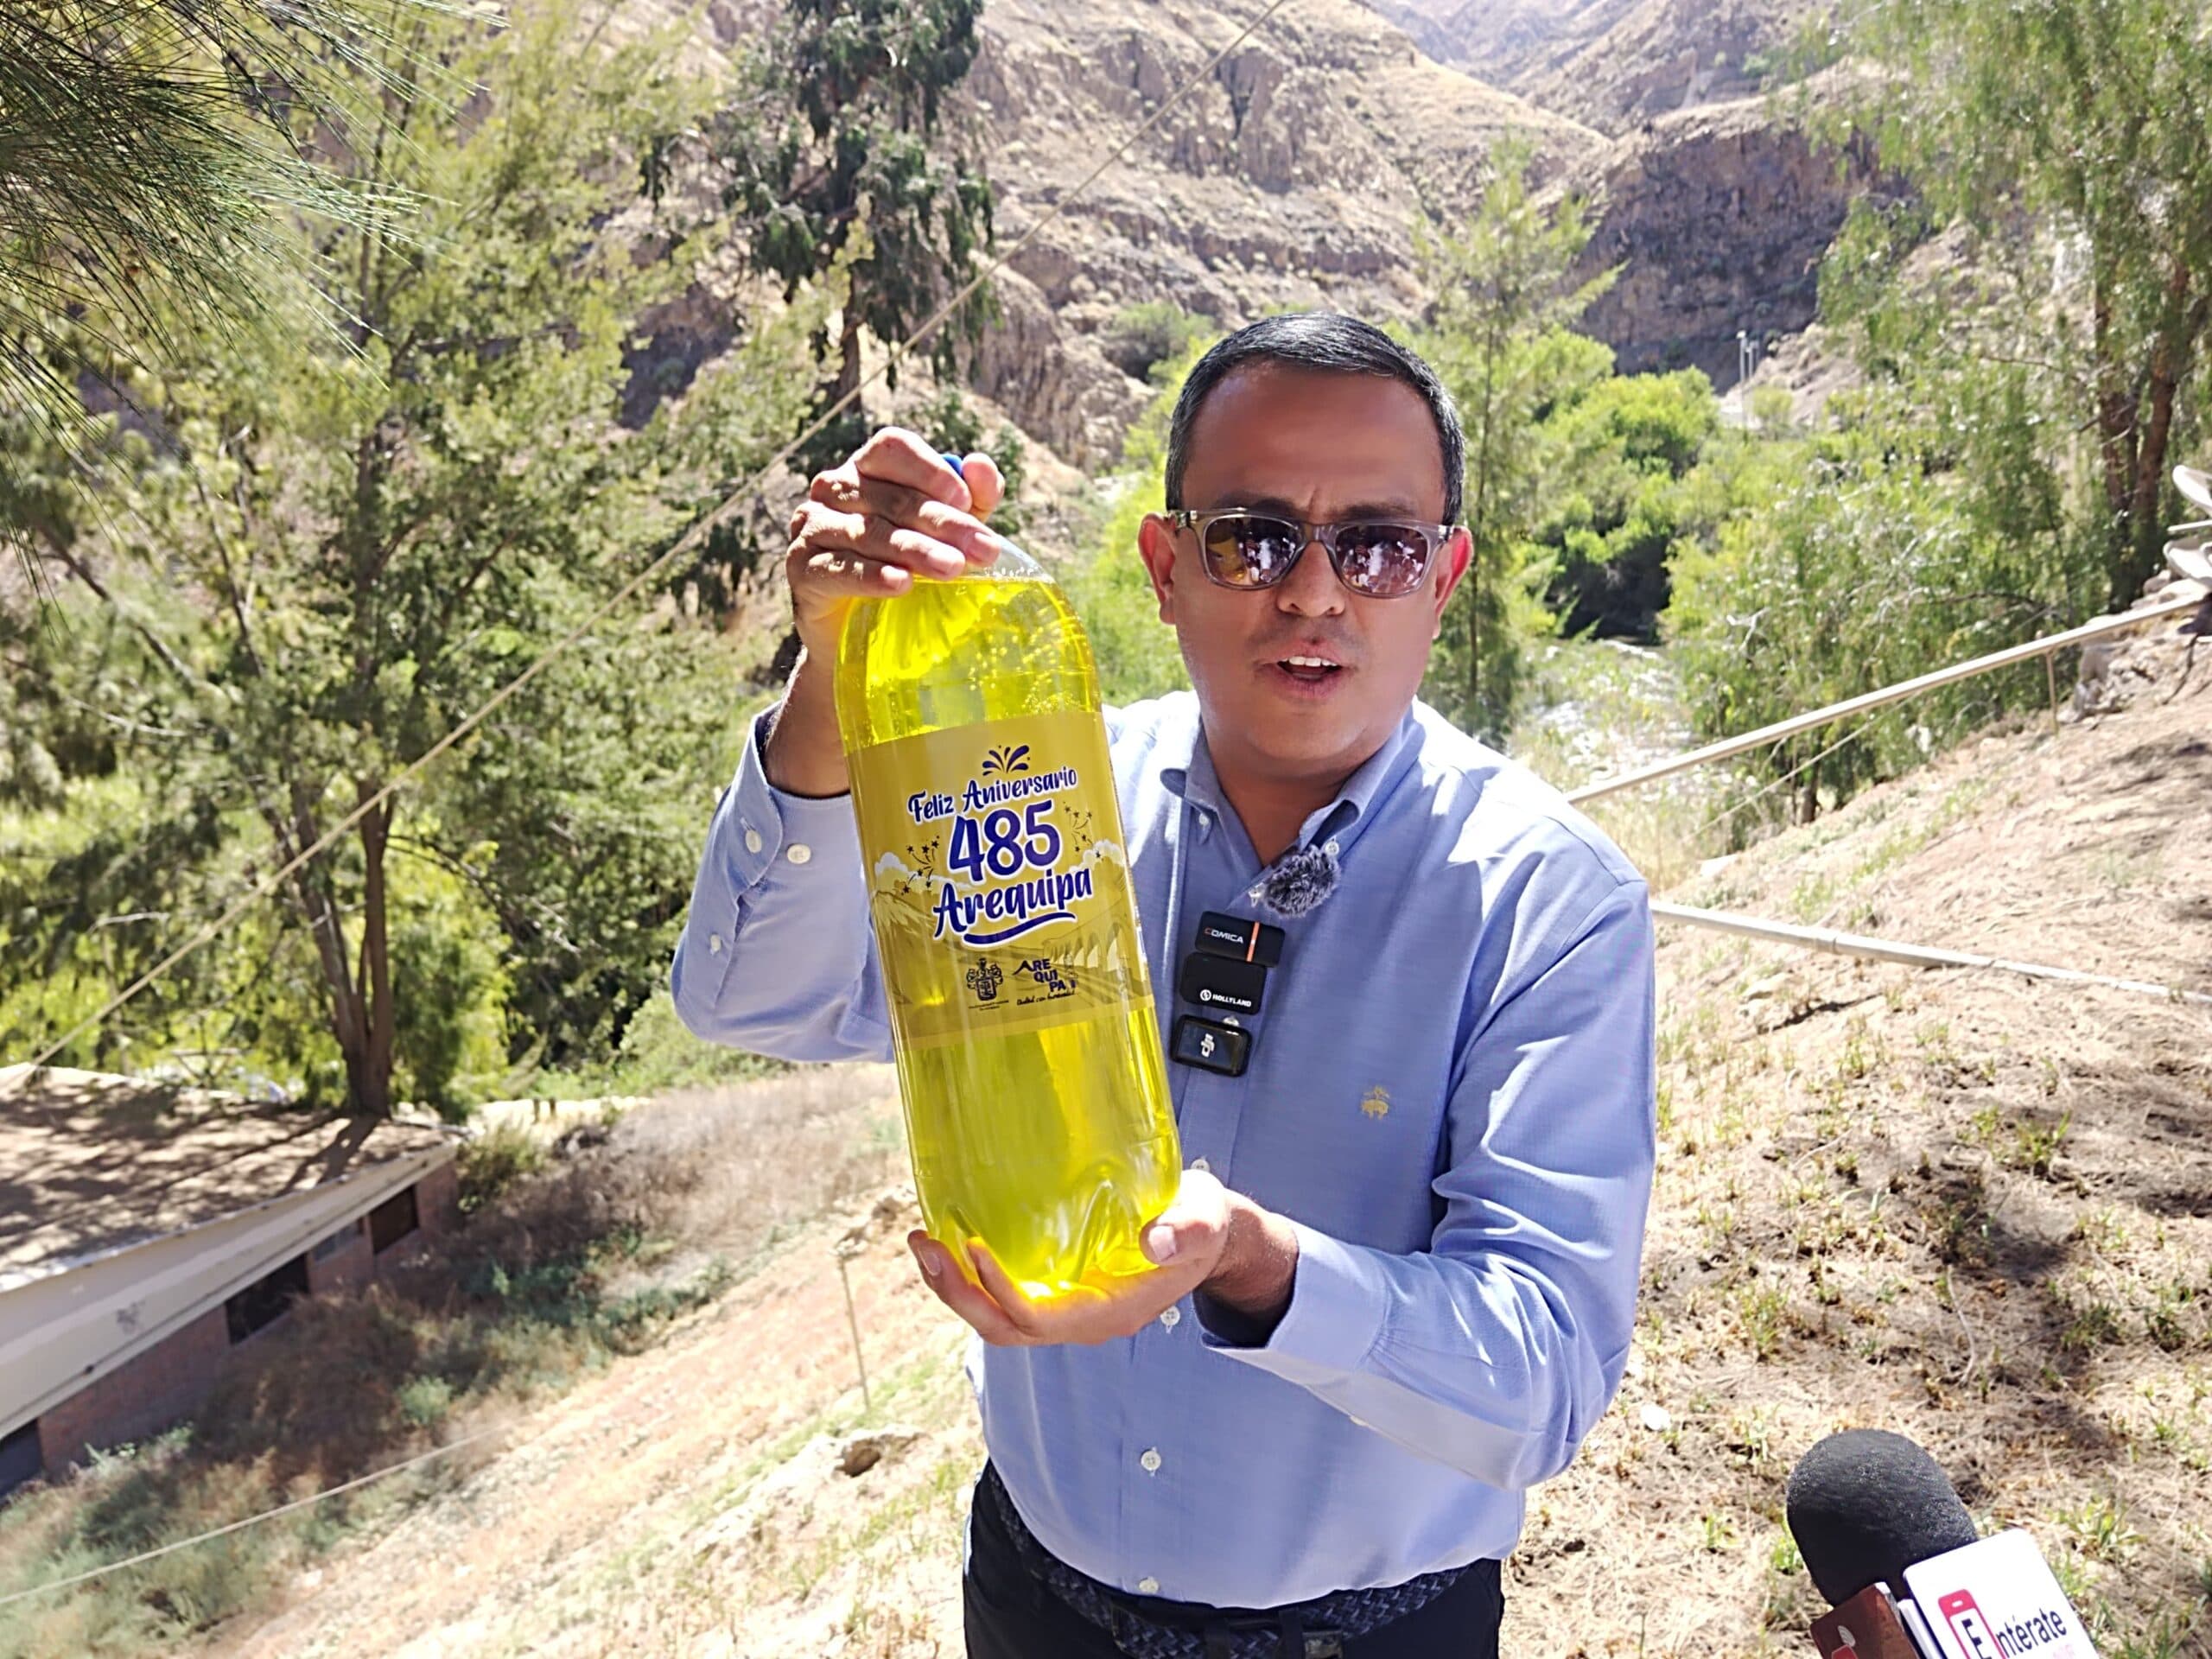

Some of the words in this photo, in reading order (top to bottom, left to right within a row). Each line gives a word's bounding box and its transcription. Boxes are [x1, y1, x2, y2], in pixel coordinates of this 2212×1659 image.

[907, 790, 955, 823] Feliz
[962, 766, 1077, 812] Aniversario
[949, 798, 1061, 882] 485
[932, 868, 1093, 938] Arequipa
[1204, 926, 1244, 944] COMICA
[1012, 958, 1052, 976] ARE
[1033, 969, 1058, 983] QUI
[1211, 993, 1252, 1007] HOLLYLAND
[1961, 1606, 2067, 1659] Entérate
